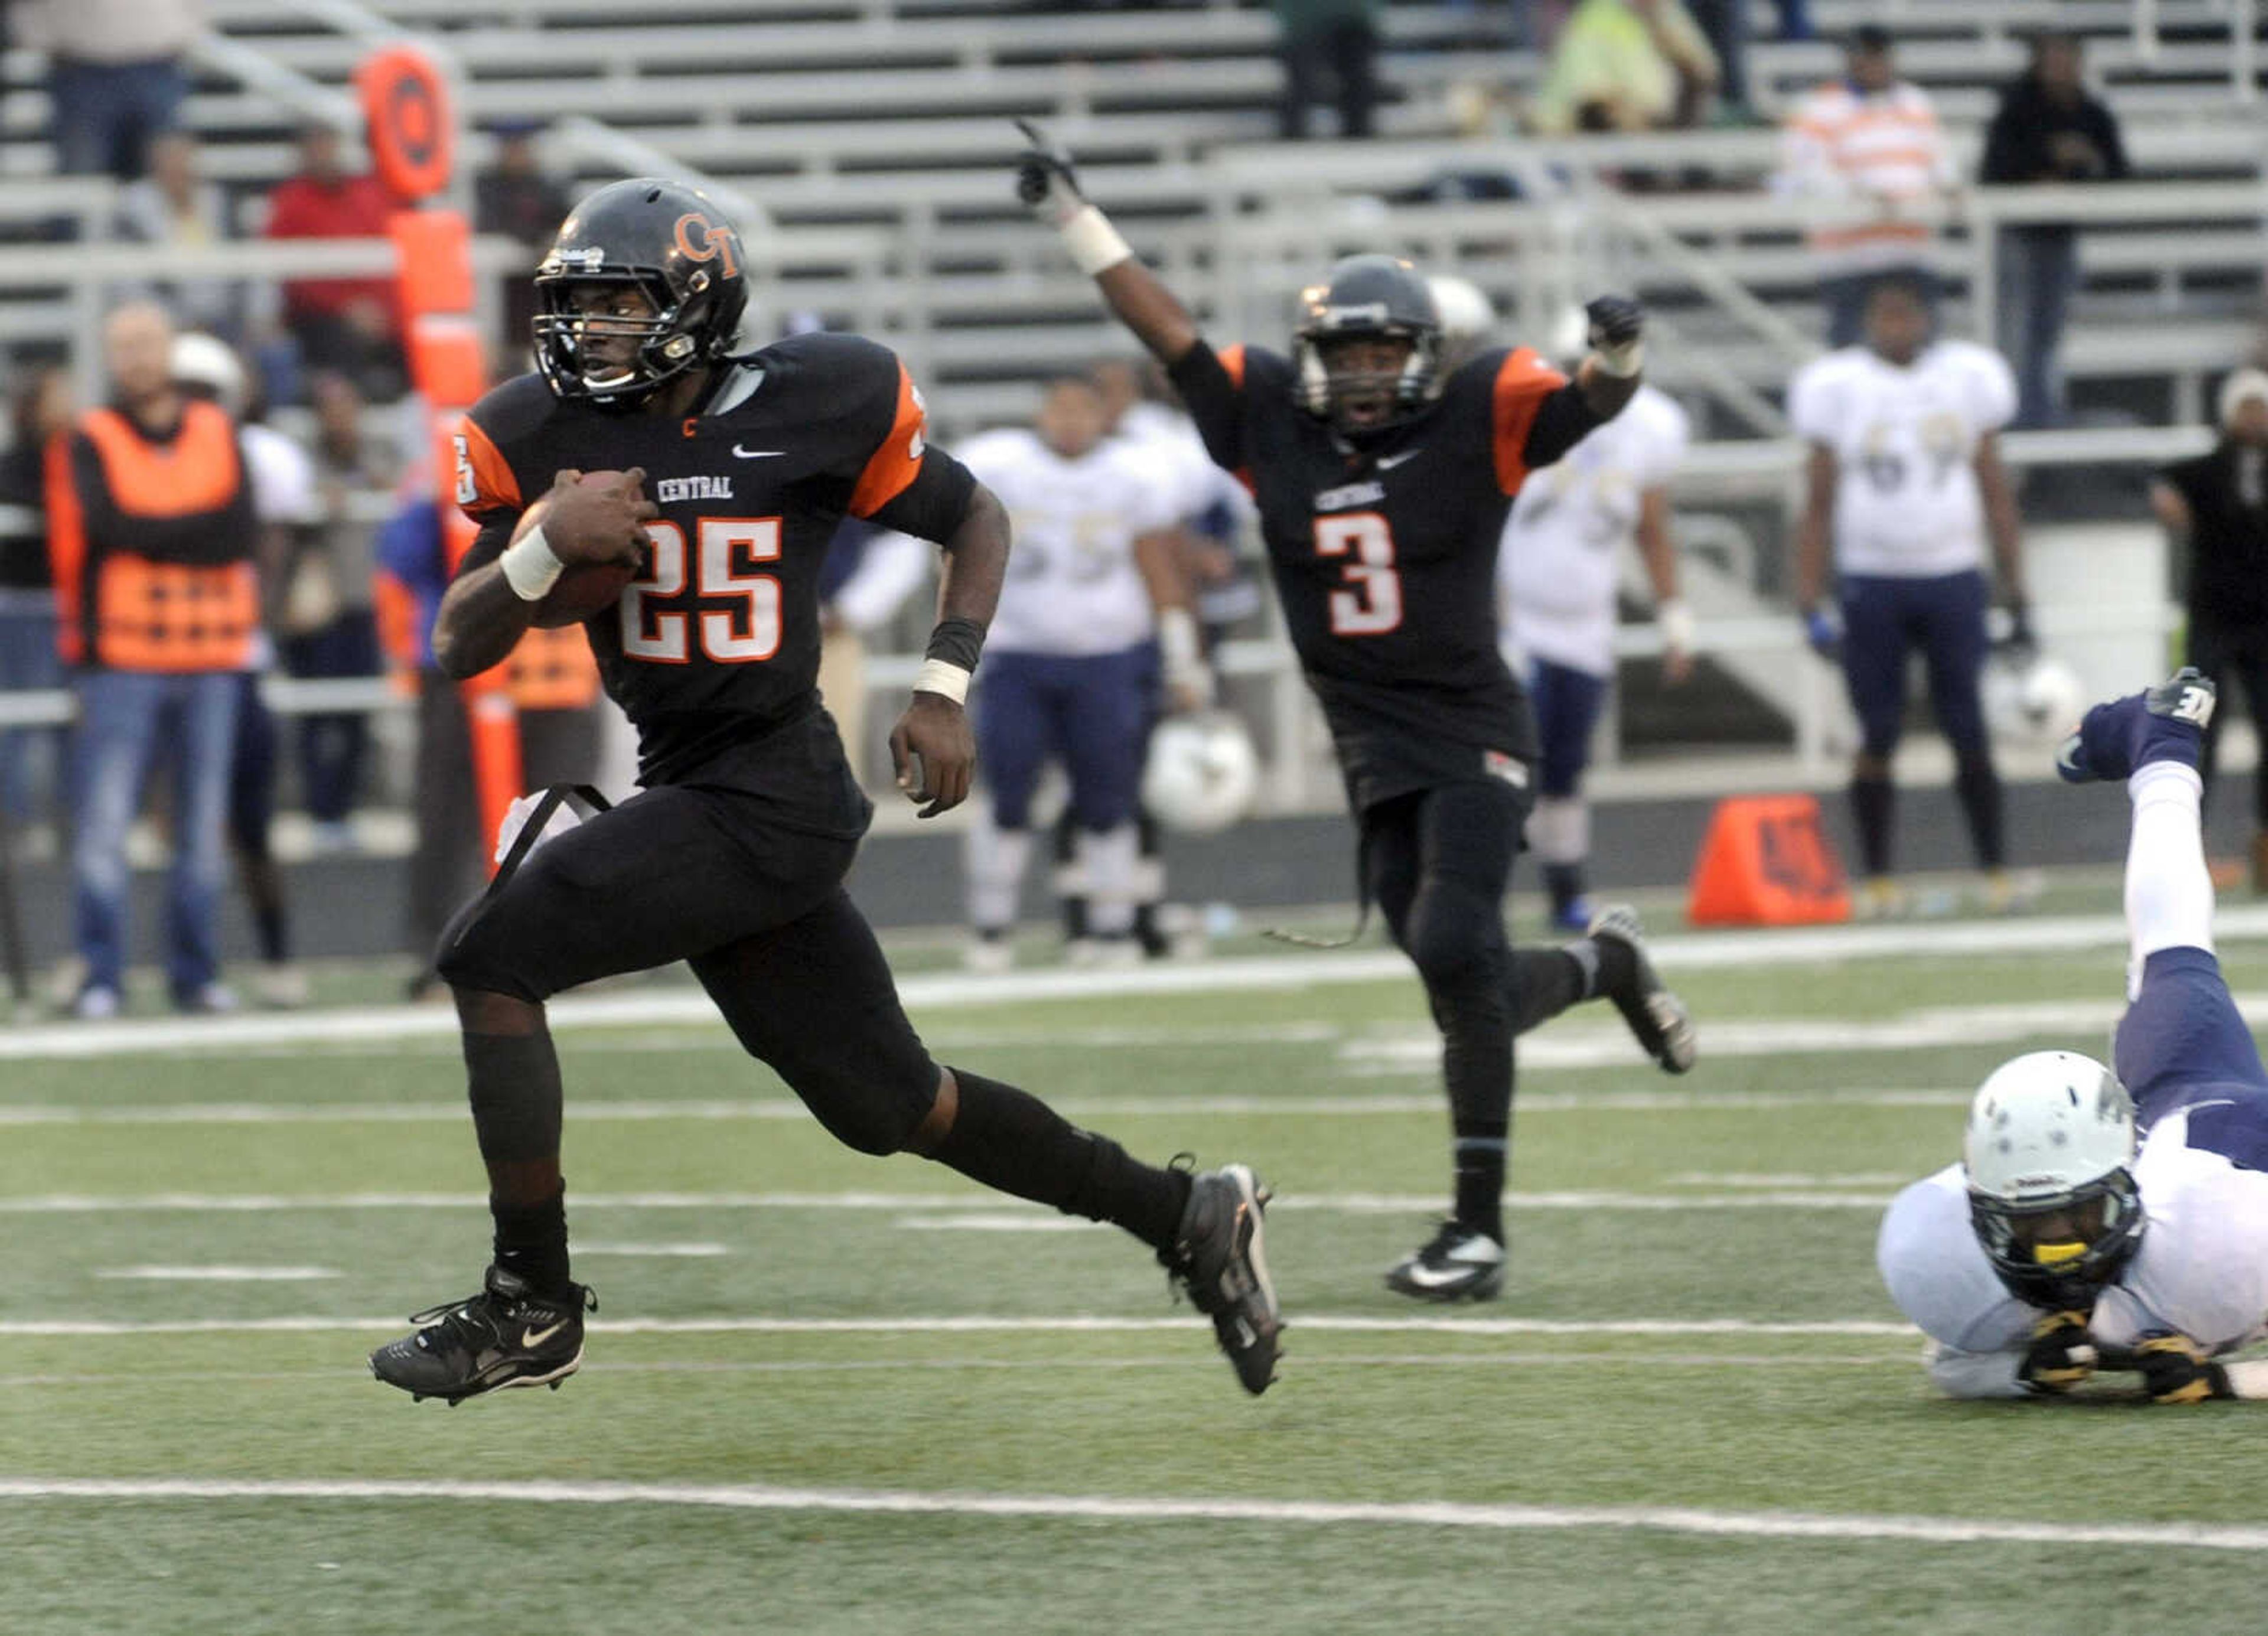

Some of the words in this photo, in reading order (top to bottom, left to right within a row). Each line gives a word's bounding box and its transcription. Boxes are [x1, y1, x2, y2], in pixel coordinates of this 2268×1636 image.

[682, 417, 699, 438] C
[657, 476, 734, 503] CENTRAL
[621, 516, 784, 663] 25
[1313, 510, 1403, 636] 3
